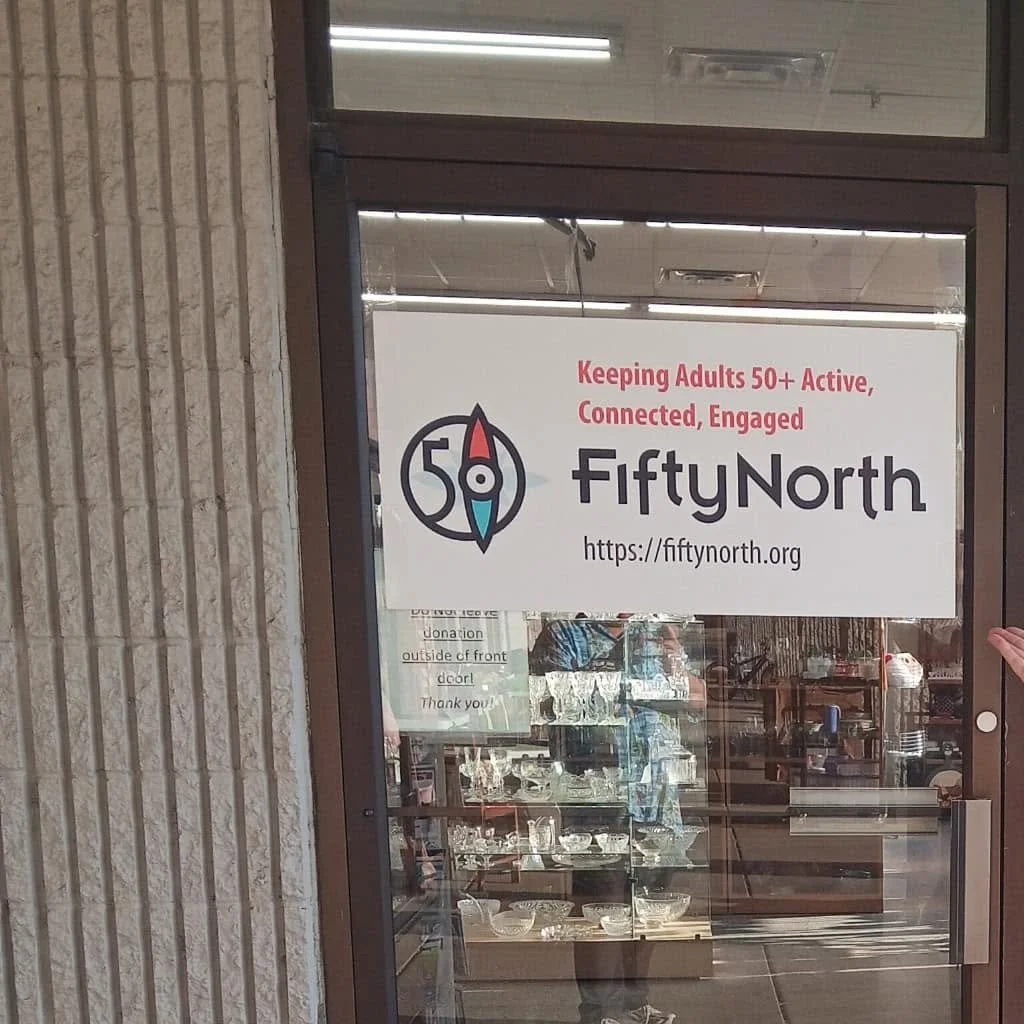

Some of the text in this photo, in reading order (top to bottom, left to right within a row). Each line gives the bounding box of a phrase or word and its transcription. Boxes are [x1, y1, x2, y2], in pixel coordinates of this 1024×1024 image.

[578, 360, 874, 397] Keeping Adults 50+ Active,
[578, 400, 804, 435] Connected, Engaged
[572, 448, 927, 523] FiftyNorth
[584, 535, 801, 571] https://fiftynorth.org
[423, 628, 483, 639] donation
[402, 650, 507, 662] outside of front
[437, 672, 474, 684] door!
[421, 697, 494, 711] Thank you!
